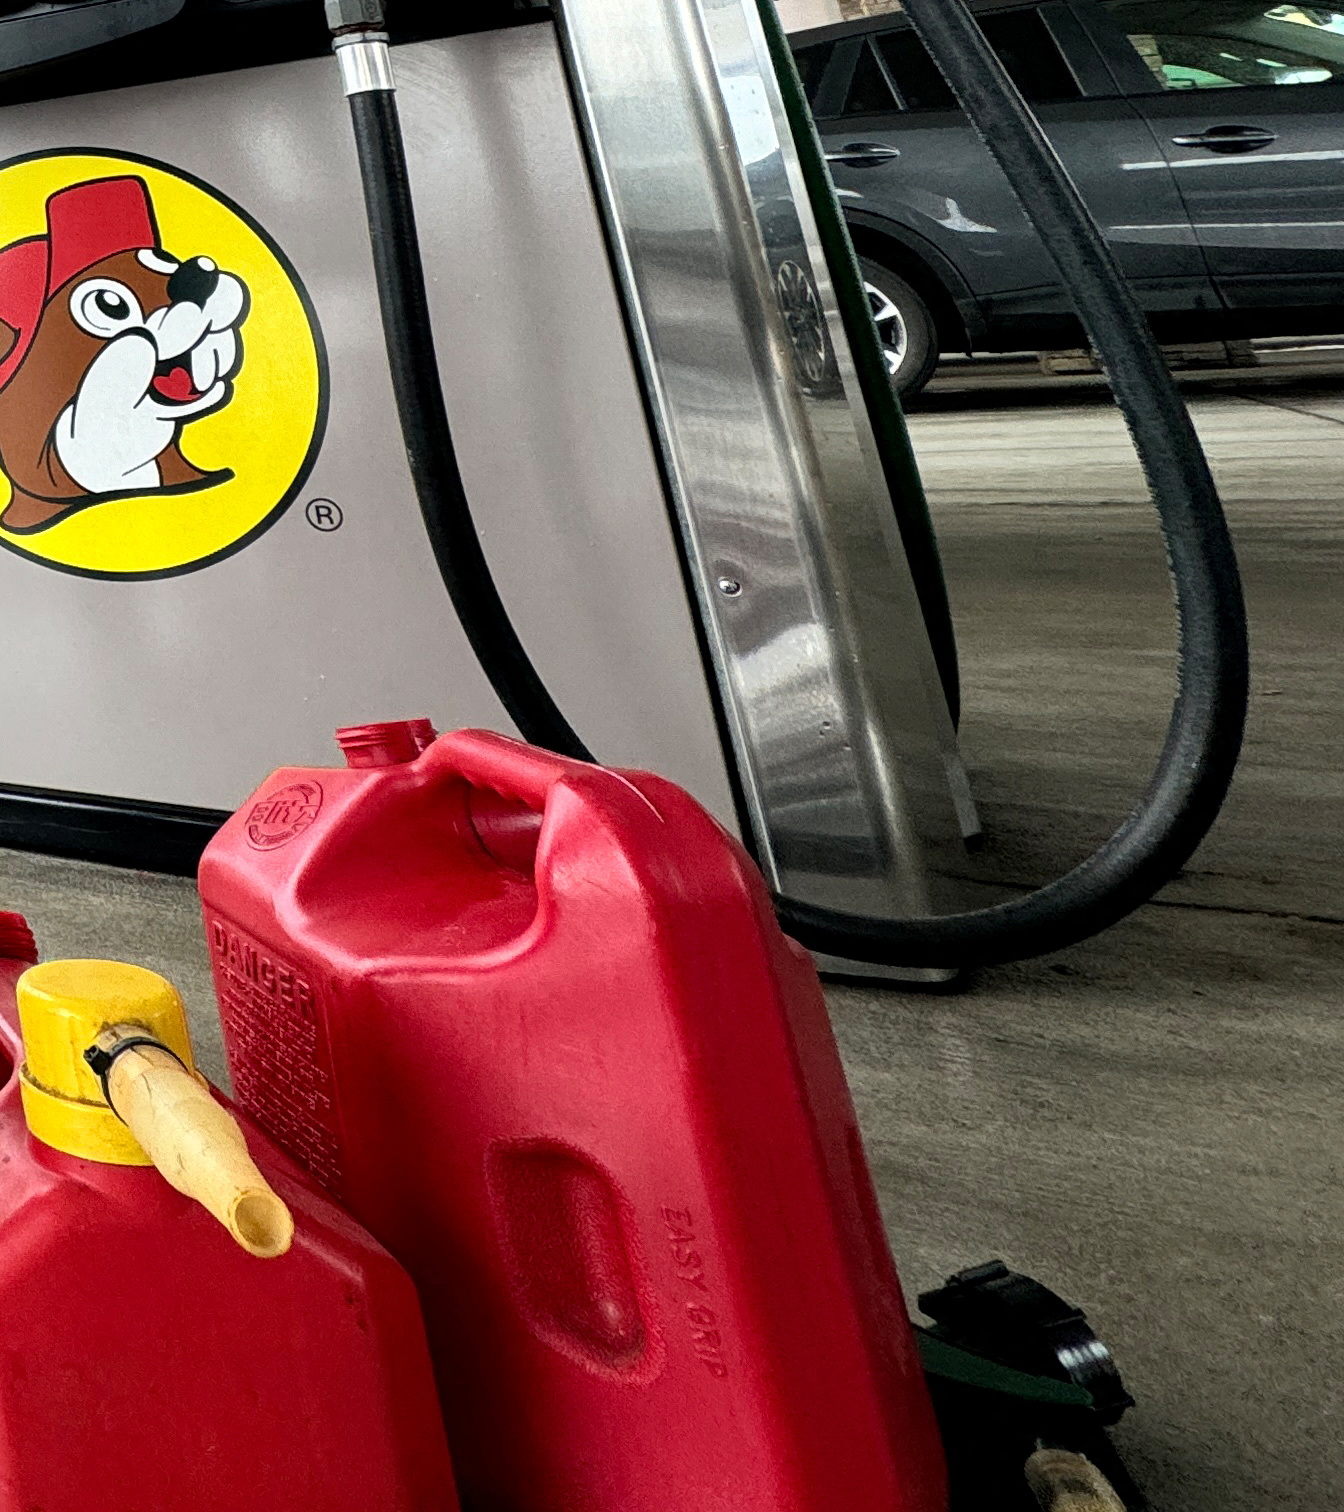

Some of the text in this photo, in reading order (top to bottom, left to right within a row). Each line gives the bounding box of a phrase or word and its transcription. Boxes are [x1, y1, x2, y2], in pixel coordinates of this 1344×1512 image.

[213, 921, 312, 1017] DANGER
[662, 1207, 708, 1292] EASY
[686, 1303, 728, 1378] GRIP
